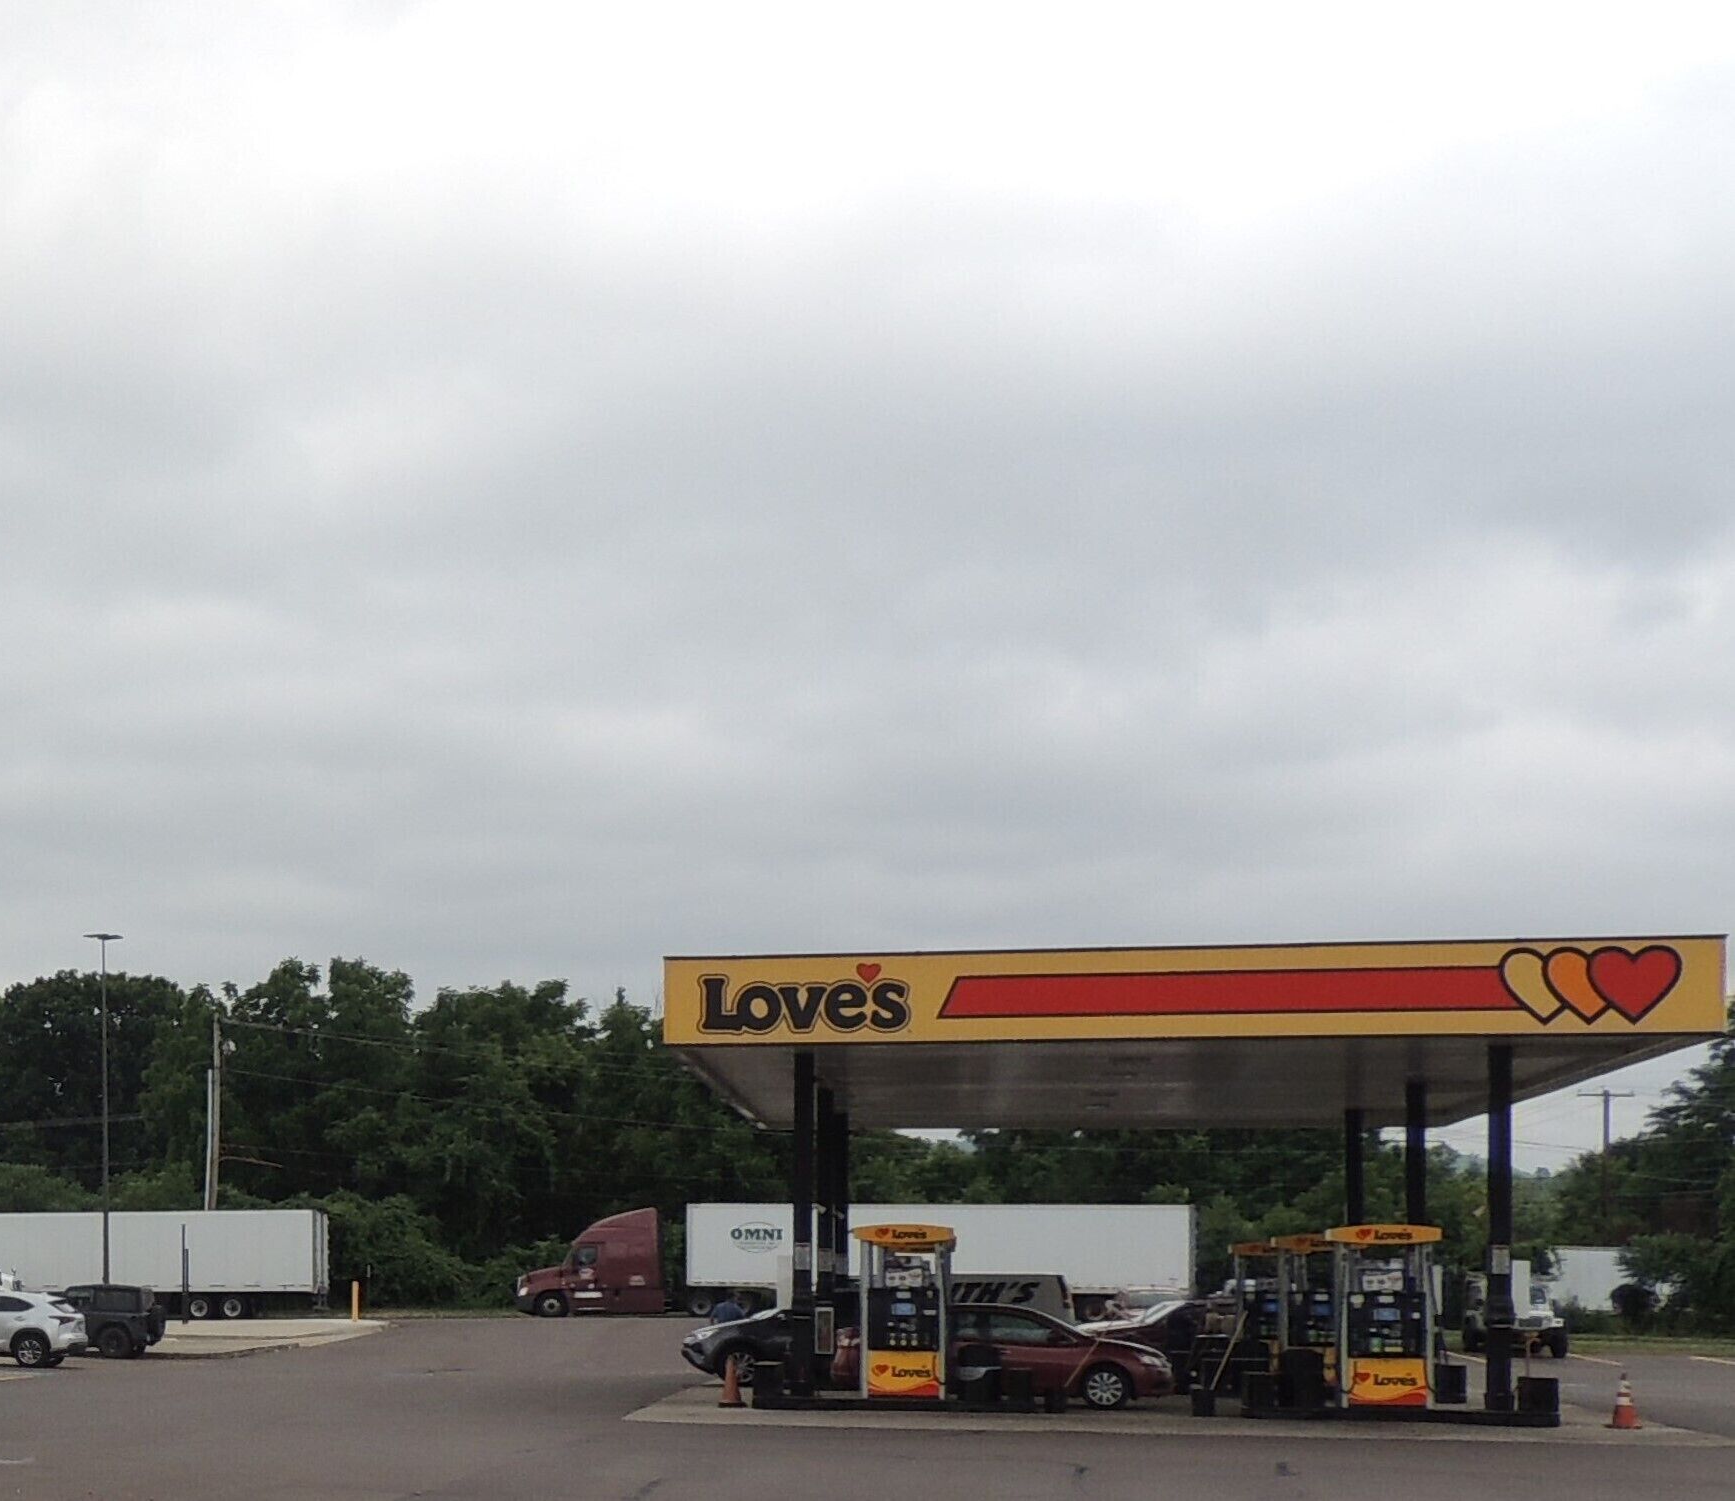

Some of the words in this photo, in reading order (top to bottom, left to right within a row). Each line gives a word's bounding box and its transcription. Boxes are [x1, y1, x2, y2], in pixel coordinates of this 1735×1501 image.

[697, 963, 911, 1036] Love's
[730, 1227, 784, 1241] OMNI
[951, 1281, 1040, 1303] ITH'S
[891, 1365, 931, 1378] Love's
[1373, 1373, 1418, 1386] Love's
